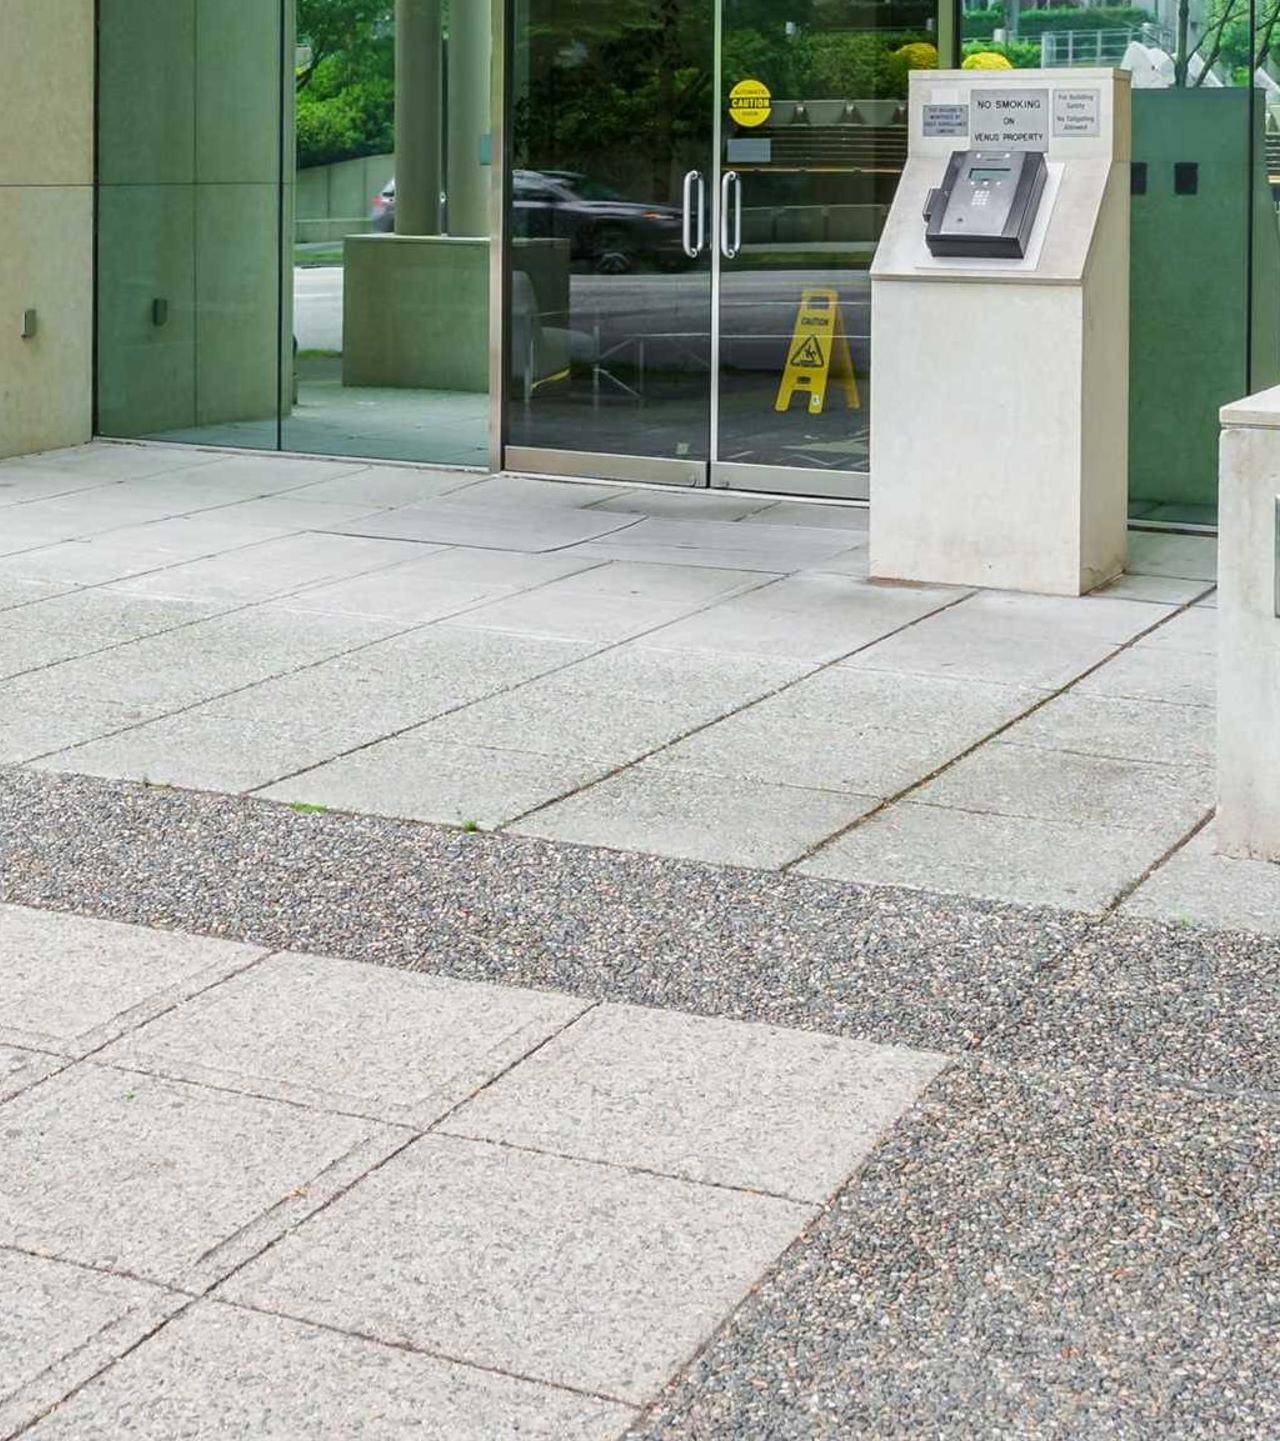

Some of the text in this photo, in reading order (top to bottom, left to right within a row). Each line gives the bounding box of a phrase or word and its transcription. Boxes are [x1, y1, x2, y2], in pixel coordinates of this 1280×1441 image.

[730, 97, 770, 109] CAUTION
[976, 100, 1041, 110] NO SMOKING
[1002, 116, 1016, 127] ON
[974, 132, 1044, 142] VENUS PROPERTY
